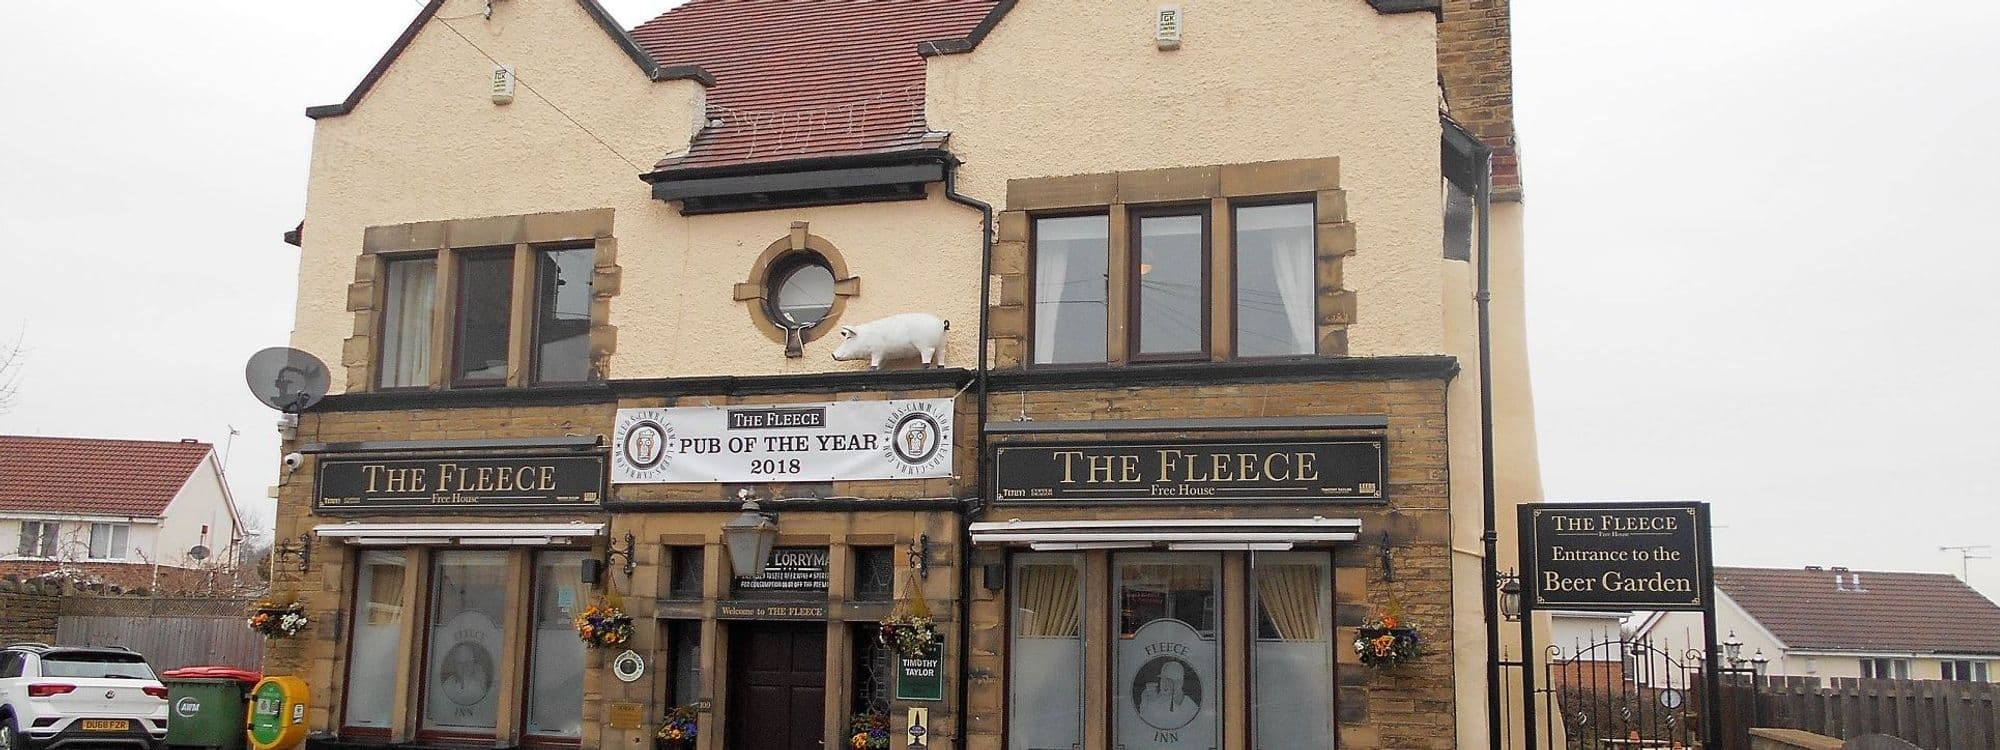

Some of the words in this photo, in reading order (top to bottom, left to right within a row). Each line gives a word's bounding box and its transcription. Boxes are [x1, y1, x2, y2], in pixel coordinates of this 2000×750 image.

[735, 413, 764, 427] THE
[766, 411, 820, 427] FLEECE
[679, 438, 721, 454] PUB
[728, 437, 758, 453] OF
[764, 436, 809, 453] THE
[816, 434, 879, 451] YEAR
[750, 459, 801, 475] 2018
[1053, 451, 1141, 483] THE
[1156, 449, 1319, 483] FLEECE
[362, 465, 426, 493] THE
[435, 463, 557, 492] FLEECE
[1151, 484, 1177, 496] Free
[1179, 484, 1216, 496] House
[431, 493, 451, 504] Free
[452, 493, 480, 504] House
[1551, 516, 1595, 531] THE
[1601, 515, 1678, 530] FLEECE
[1552, 546, 1628, 561] Entrance
[1632, 548, 1649, 561] to
[1654, 546, 1681, 561] the
[1544, 571, 1596, 591] Beer
[1602, 571, 1691, 592] Garden
[722, 606, 754, 616] Welcome
[757, 607, 765, 615] to
[768, 607, 787, 616] THE
[789, 607, 823, 616] FLEECE
[1145, 642, 1190, 657] FLEECE
[902, 659, 938, 667] TIMOTHY
[905, 668, 934, 676] TAYLOR
[181, 703, 200, 712] AWM
[1153, 731, 1179, 744] INN
